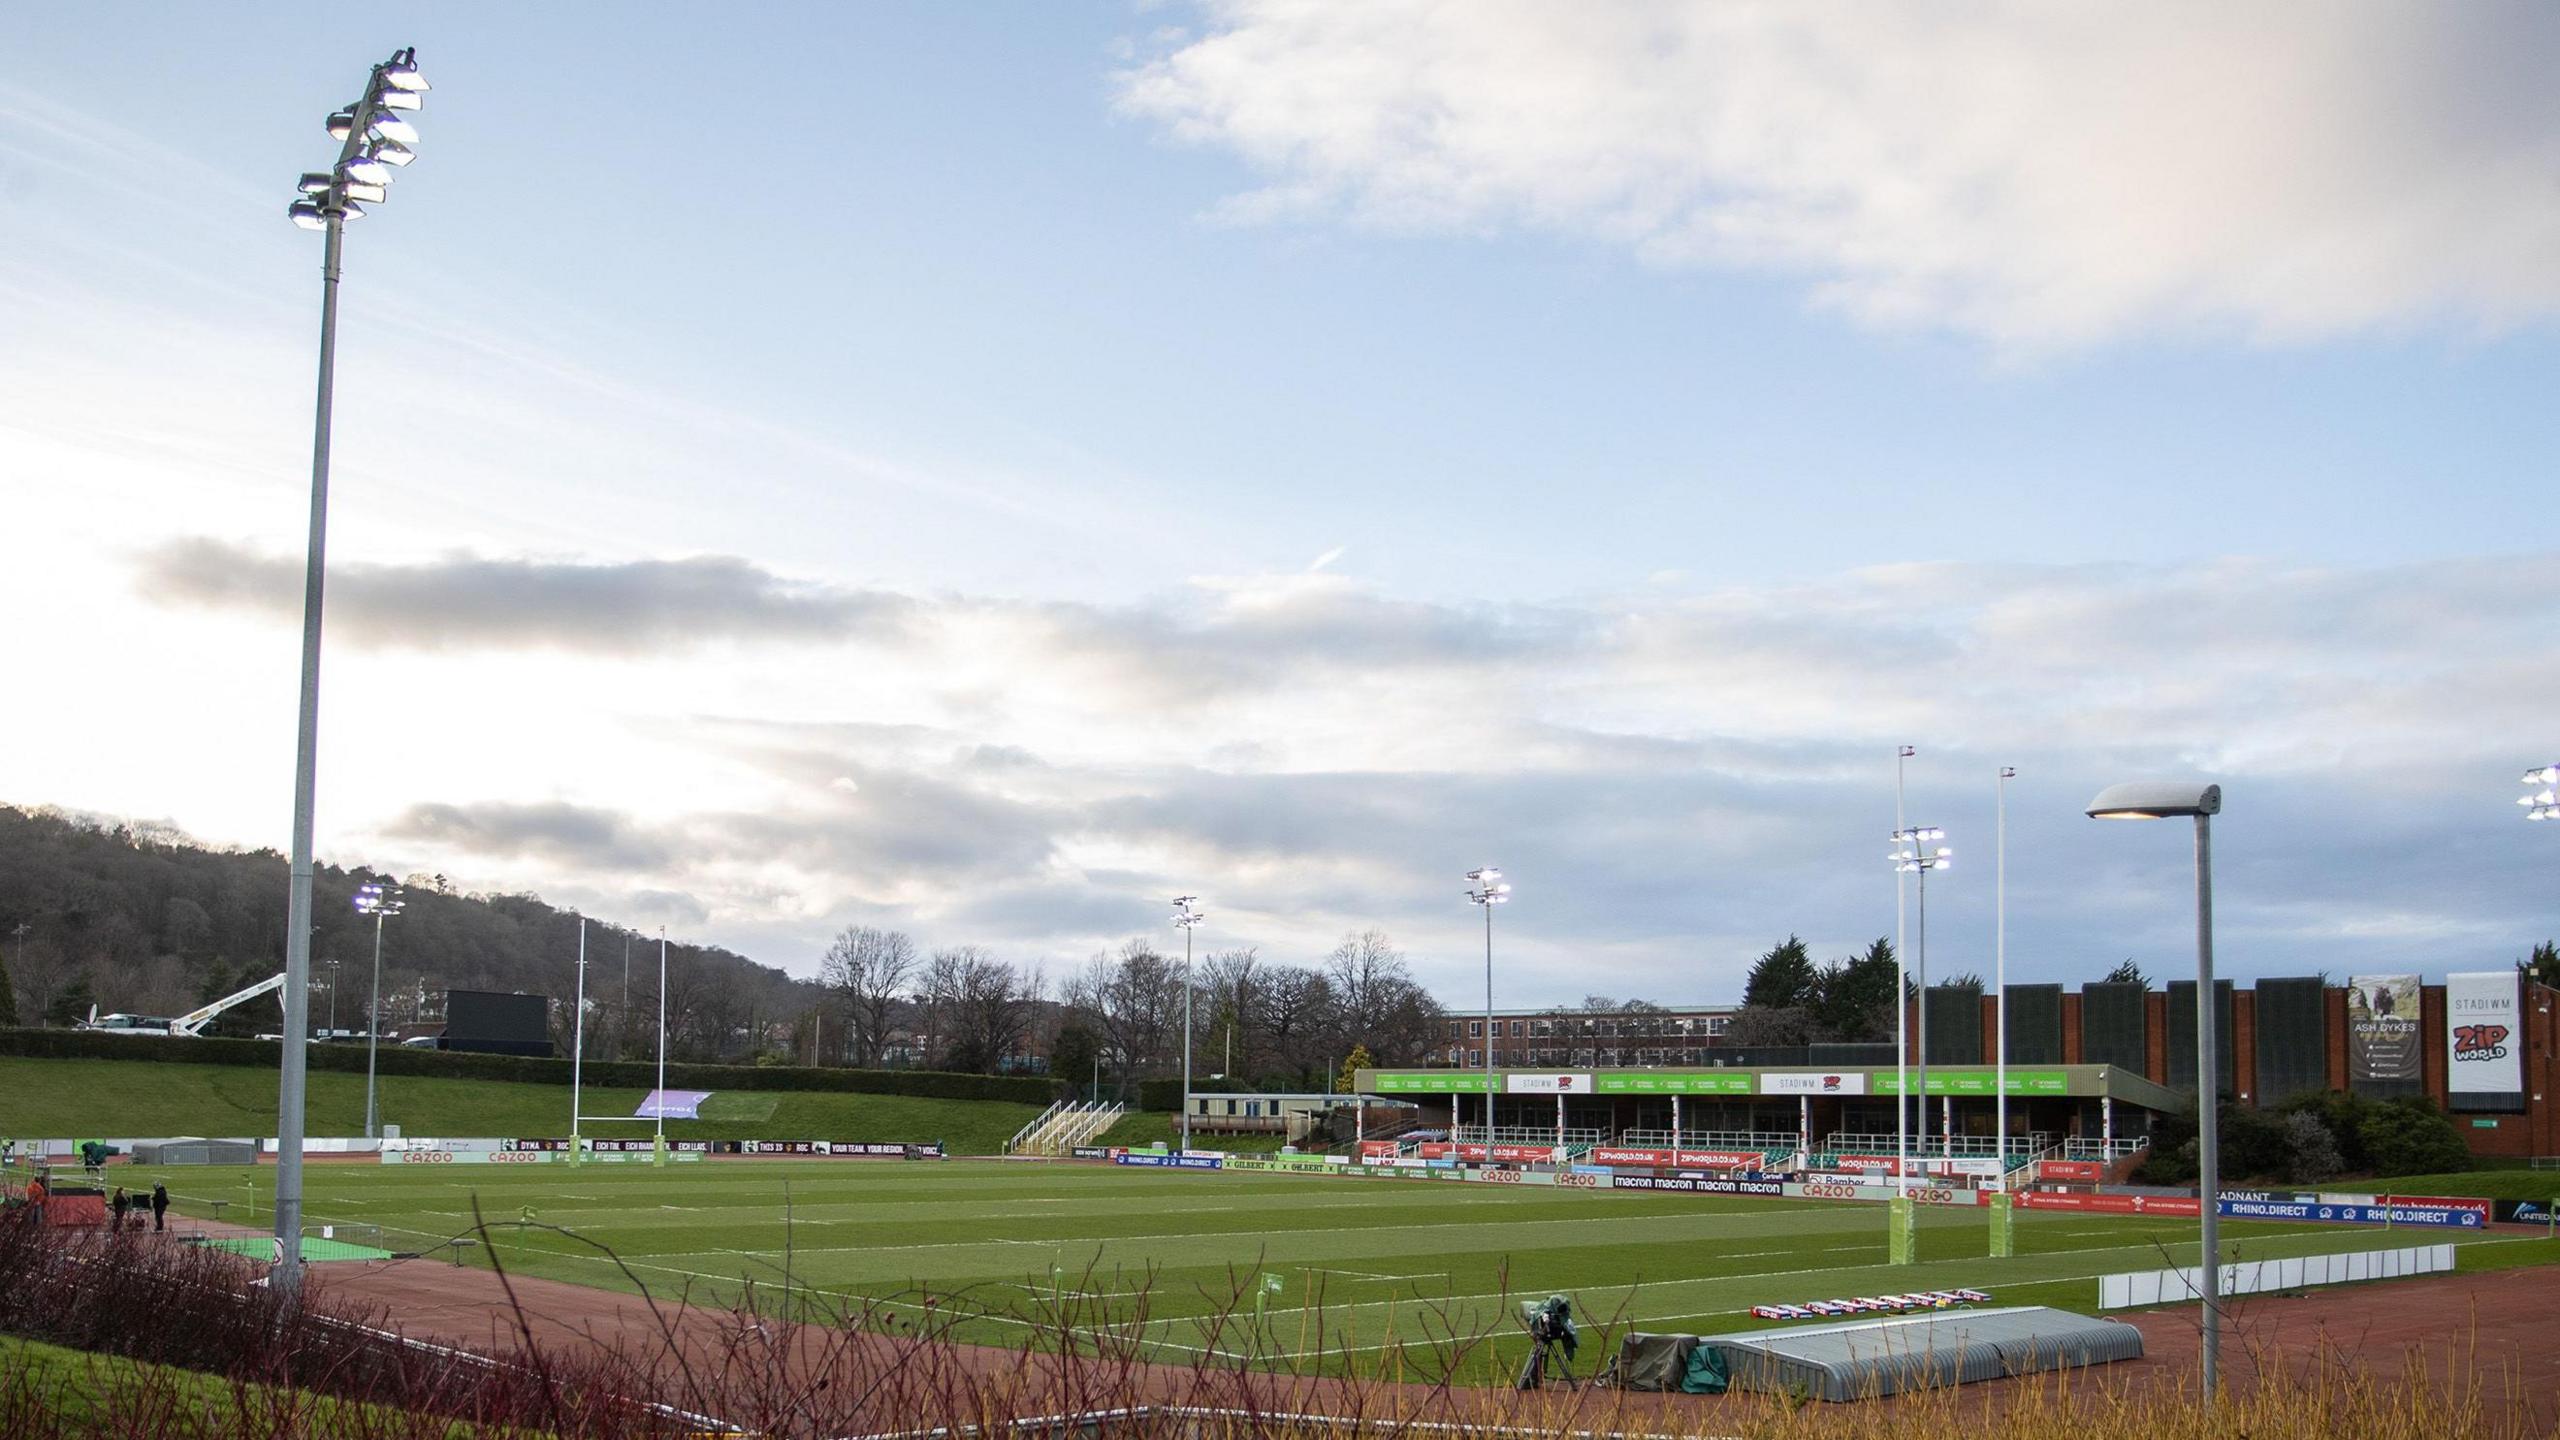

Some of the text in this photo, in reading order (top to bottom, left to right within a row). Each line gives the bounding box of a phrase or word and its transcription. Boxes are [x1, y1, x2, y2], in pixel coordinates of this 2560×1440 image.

[2455, 999, 2510, 1010] STADIWM
[2354, 1023, 2417, 1032] ASH DYKES
[2454, 1046, 2508, 1061] WORLD
[759, 1143, 775, 1151] THIS
[775, 1143, 784, 1151] IS
[832, 1144, 848, 1152] YOUR
[867, 1145, 883, 1153] YOUR
[403, 1153, 453, 1163] CAZOO
[489, 1152, 537, 1162] CAZOO
[1234, 1161, 1265, 1170] GILBERT
[1291, 1163, 1324, 1172] GILBERT
[1480, 1170, 1521, 1182] CAZOO
[1615, 1177, 1780, 1193] macron macron macron macron
[1802, 1184, 1855, 1198] CAZOO
[1897, 1187, 1952, 1202] AZOO
[2232, 1203, 2308, 1217] RHINO.DIRECT
[2367, 1209, 2448, 1223] RHINO.DIRECT
[2519, 1212, 2550, 1221] UNITED
